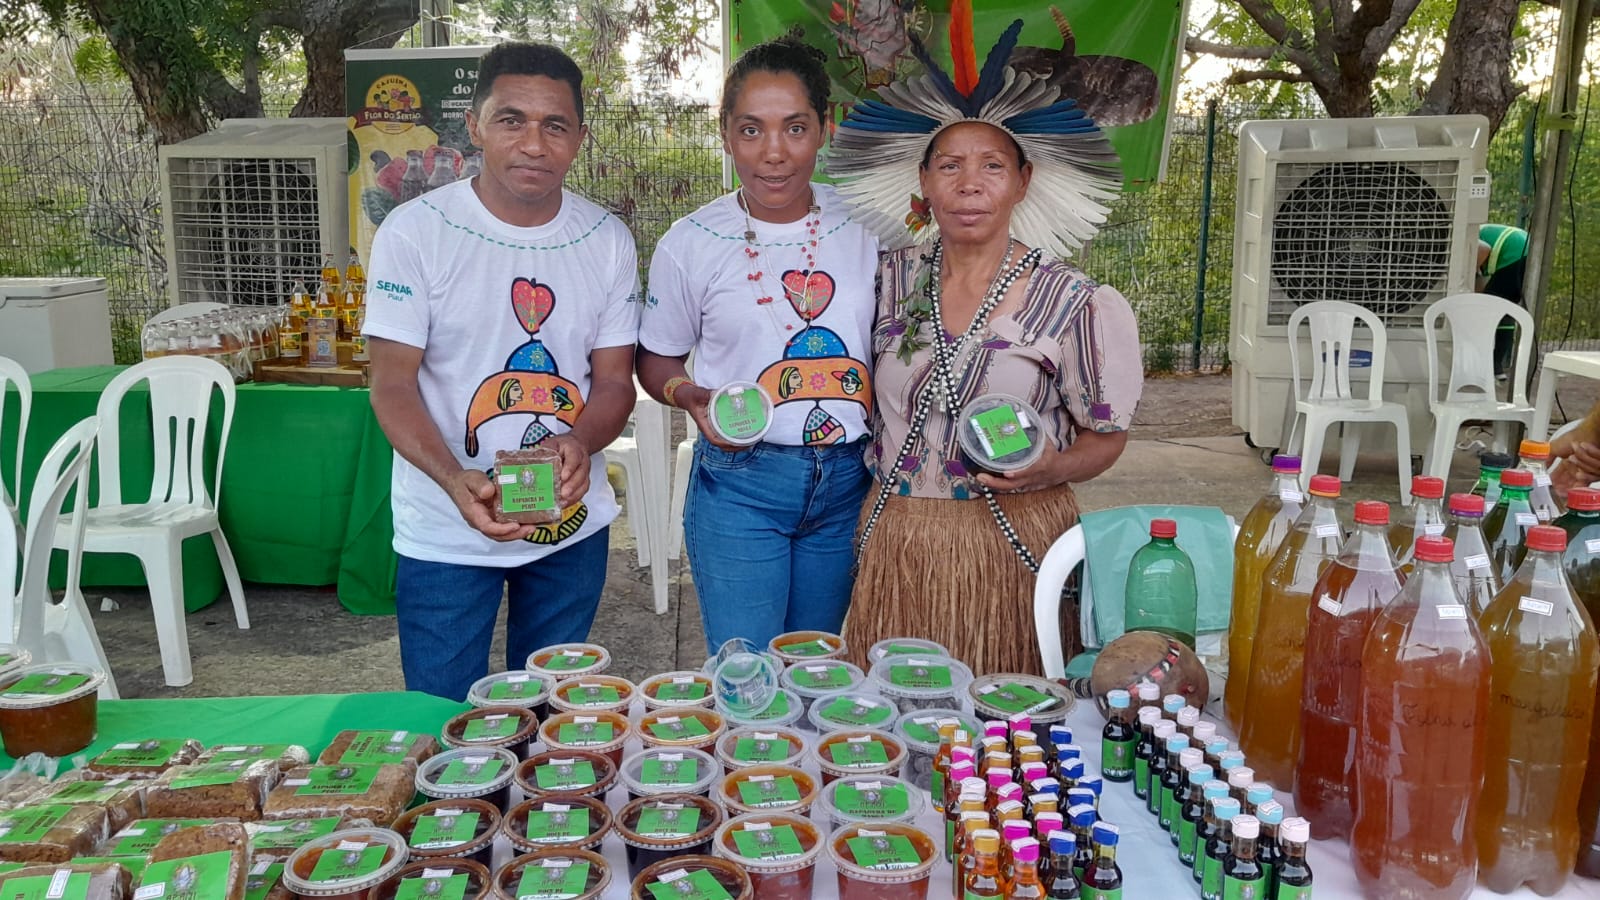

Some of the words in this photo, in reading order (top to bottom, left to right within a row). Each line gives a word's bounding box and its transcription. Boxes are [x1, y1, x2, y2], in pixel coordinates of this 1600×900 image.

[454, 67, 465, 80] O
[452, 83, 472, 95] do
[376, 279, 413, 296] SENAR
